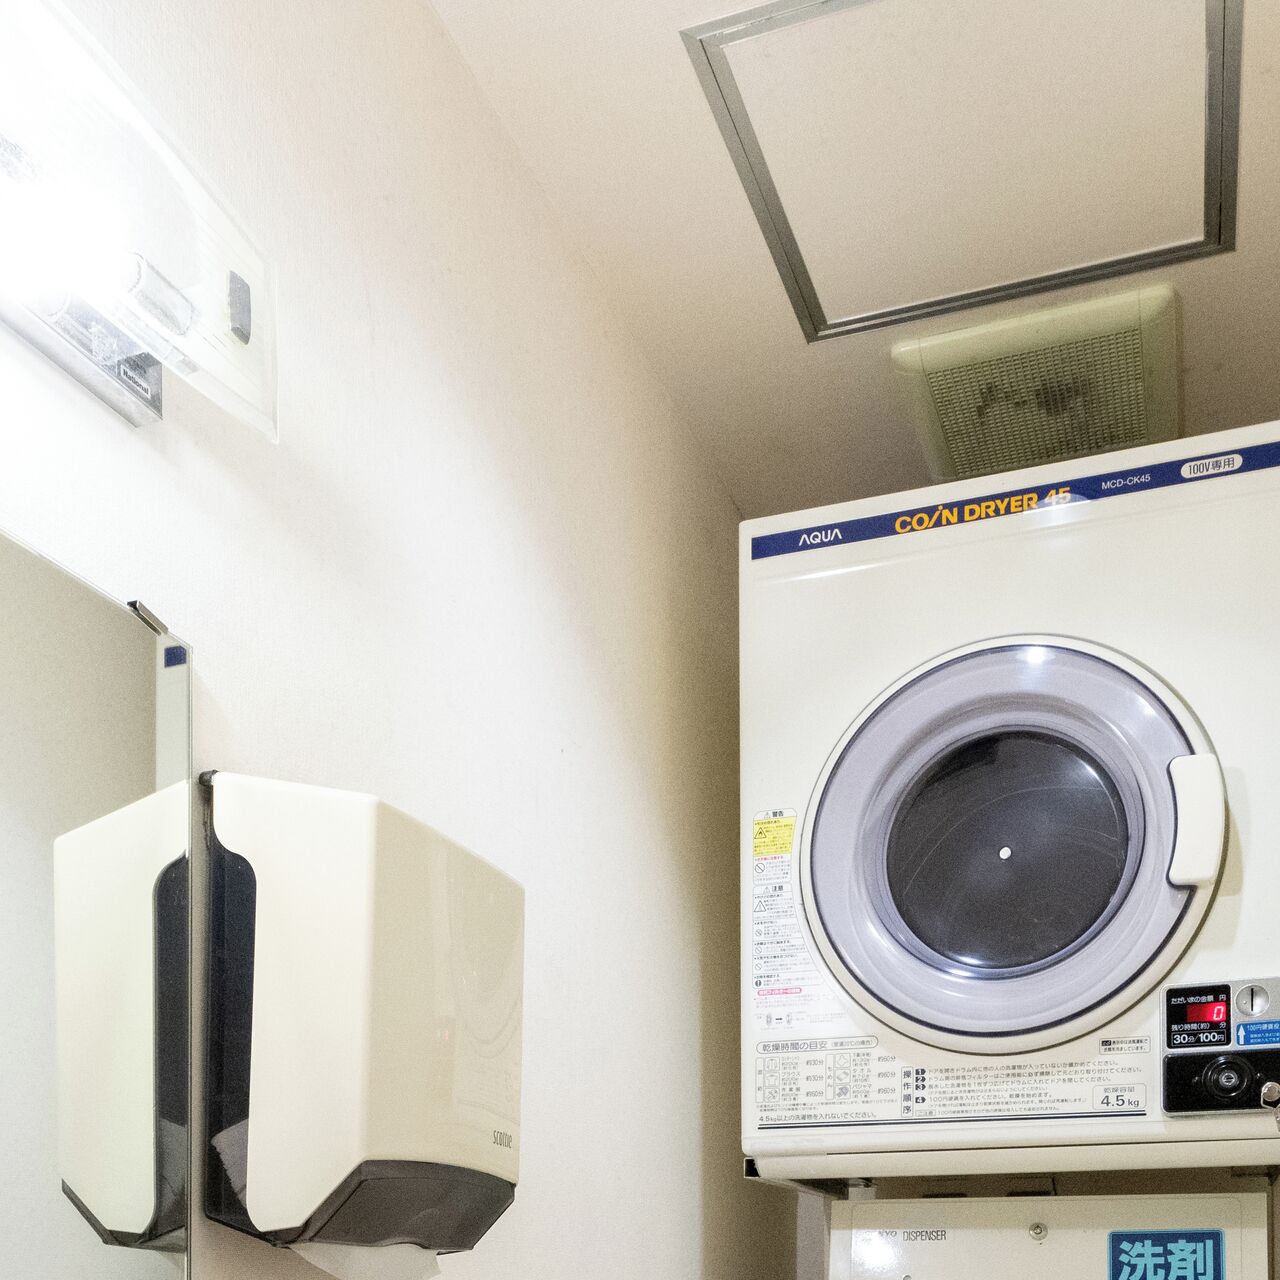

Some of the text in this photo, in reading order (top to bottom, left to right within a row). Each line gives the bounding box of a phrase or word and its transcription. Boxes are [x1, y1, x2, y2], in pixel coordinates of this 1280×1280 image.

[1101, 474, 1151, 490] MCD-CK45
[965, 493, 1038, 521] DRYER
[1045, 487, 1071, 505] 45
[799, 528, 842, 547] AQUA
[1171, 995, 1214, 1005] ただいまの金額
[1213, 1005, 1224, 1021] 0
[762, 1041, 827, 1052] 乾燥時間の目安
[1100, 1094, 1126, 1107] 4.5
[1127, 1098, 1140, 1107] kg
[903, 1230, 947, 1241] DISPENSER
